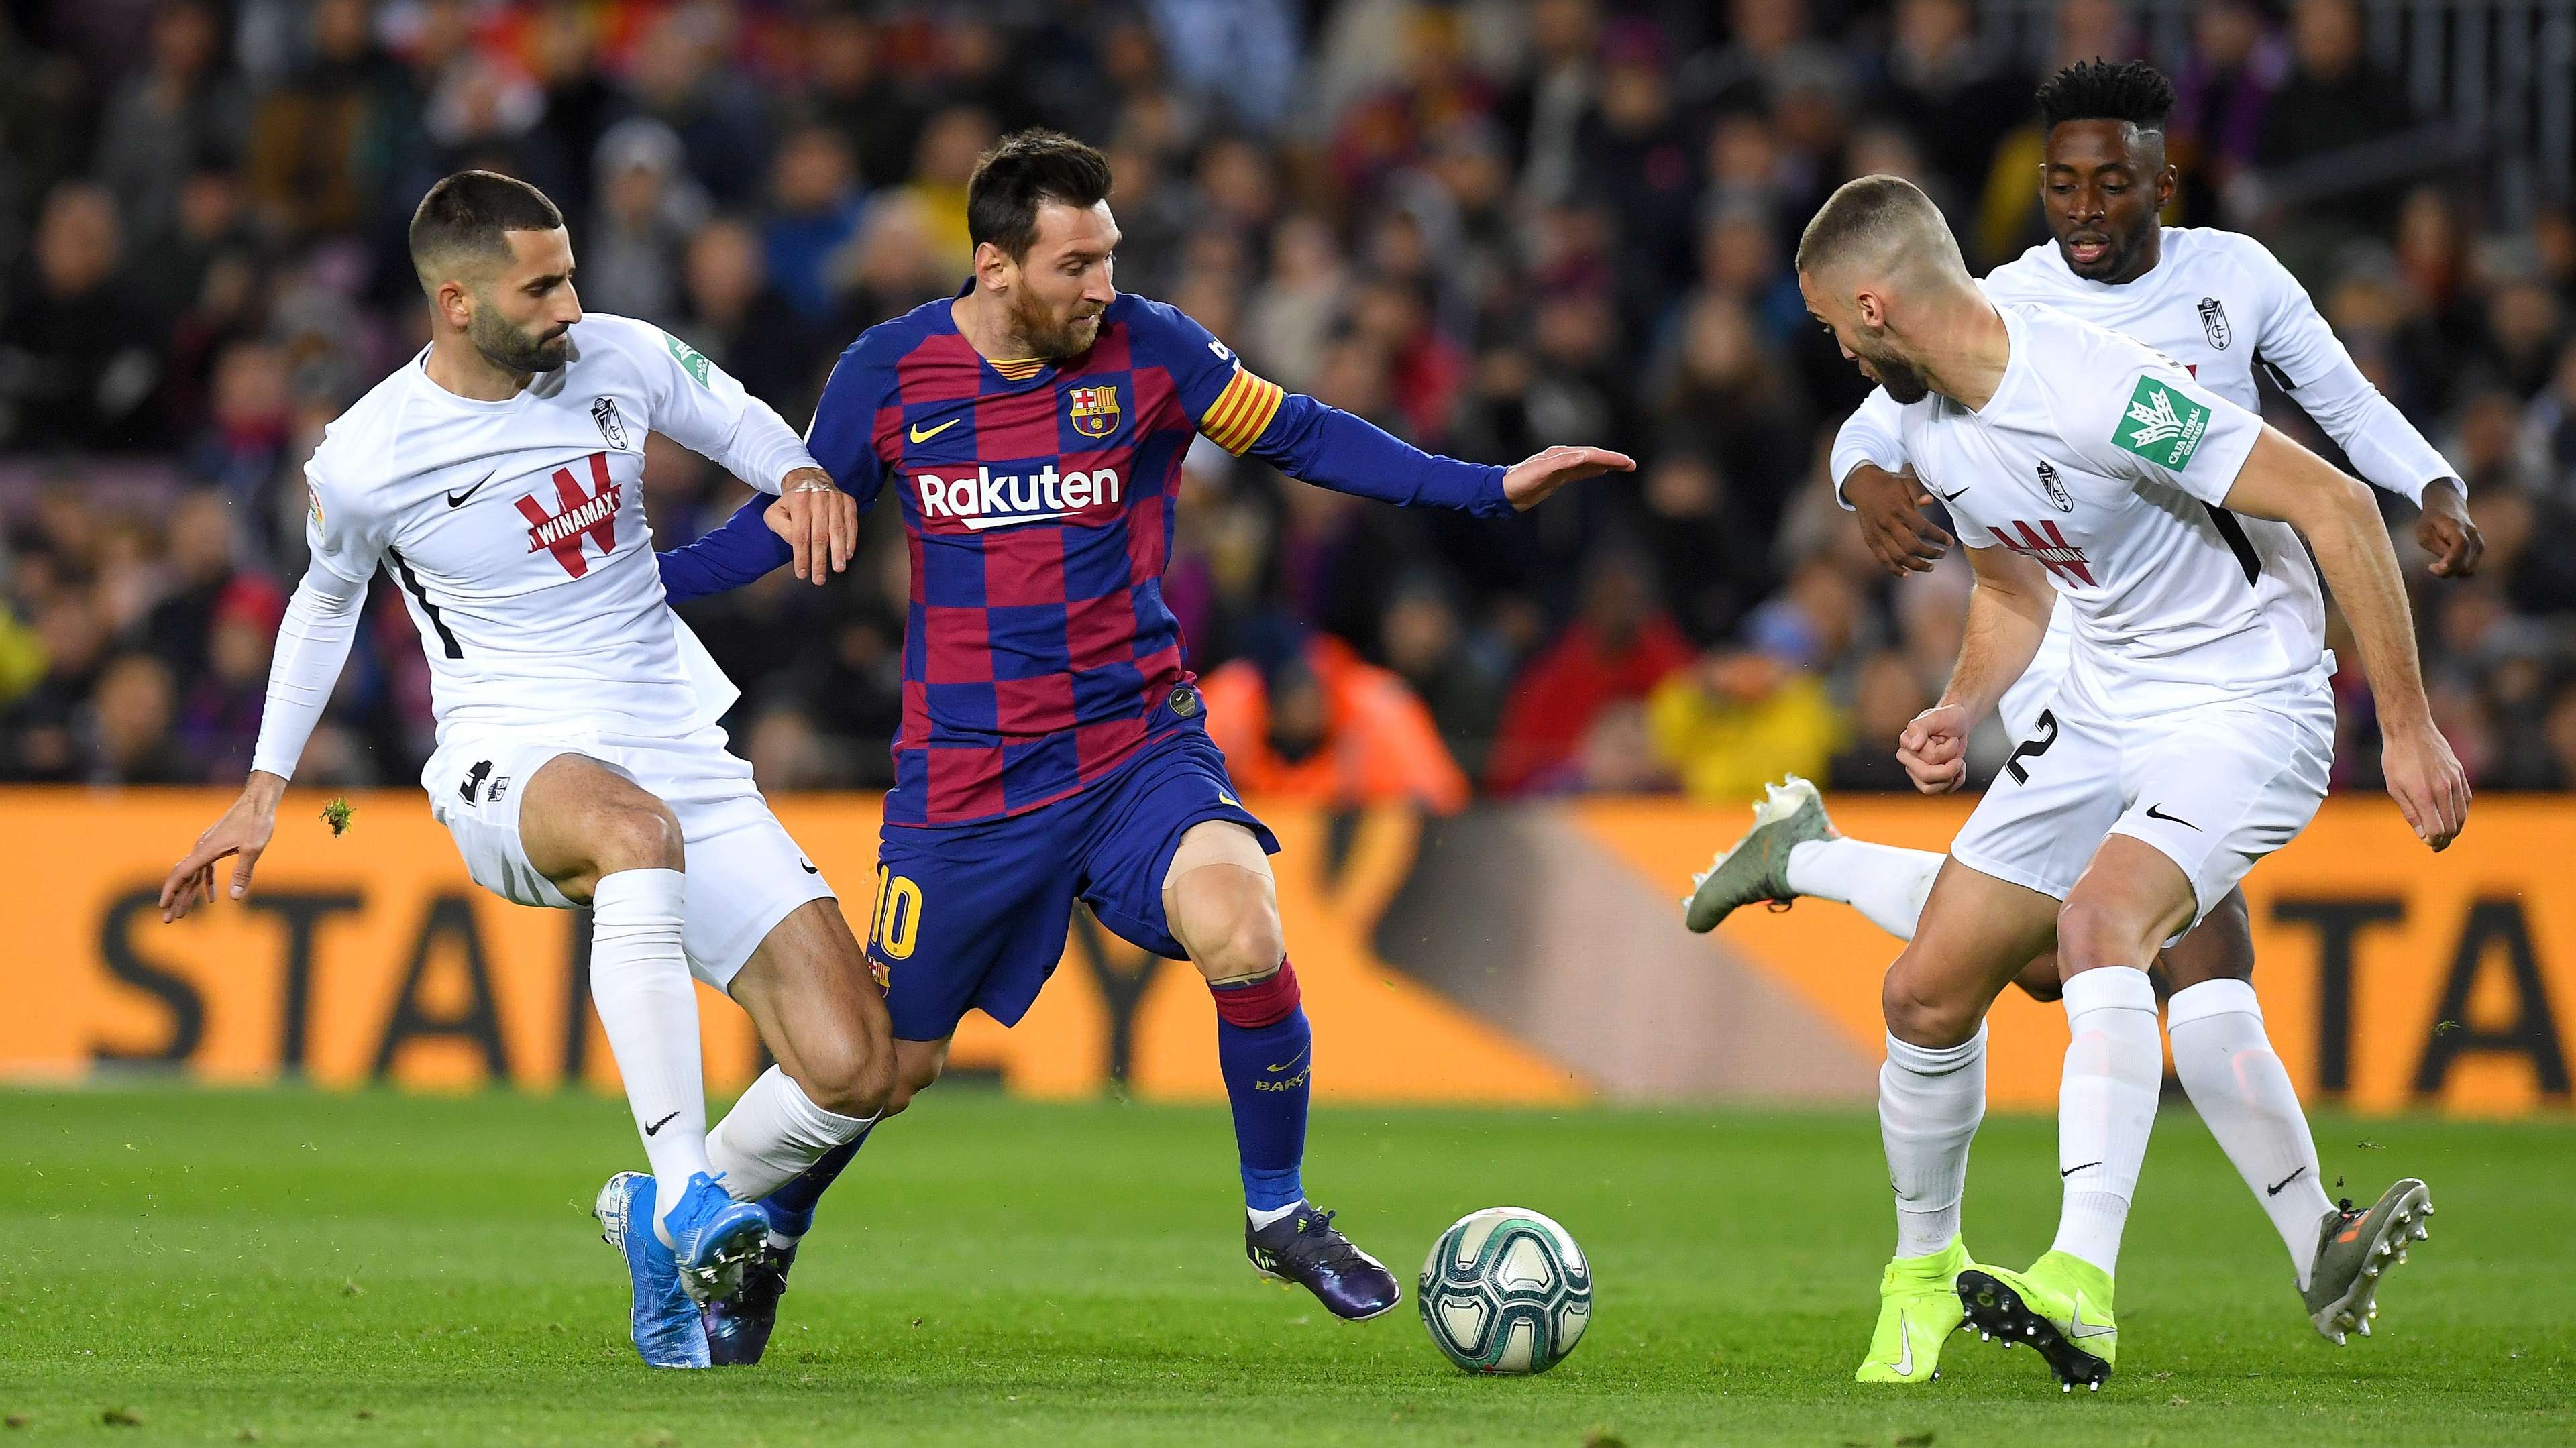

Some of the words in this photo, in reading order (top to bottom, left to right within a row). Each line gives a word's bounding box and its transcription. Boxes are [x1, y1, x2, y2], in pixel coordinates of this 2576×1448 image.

[2168, 440, 2188, 464] CAJA
[2181, 408, 2201, 439] RURAL
[537, 491, 616, 546] WINAMAX
[918, 465, 1120, 517] Rakuten
[2004, 708, 2058, 787] 2
[870, 864, 923, 960] 10
